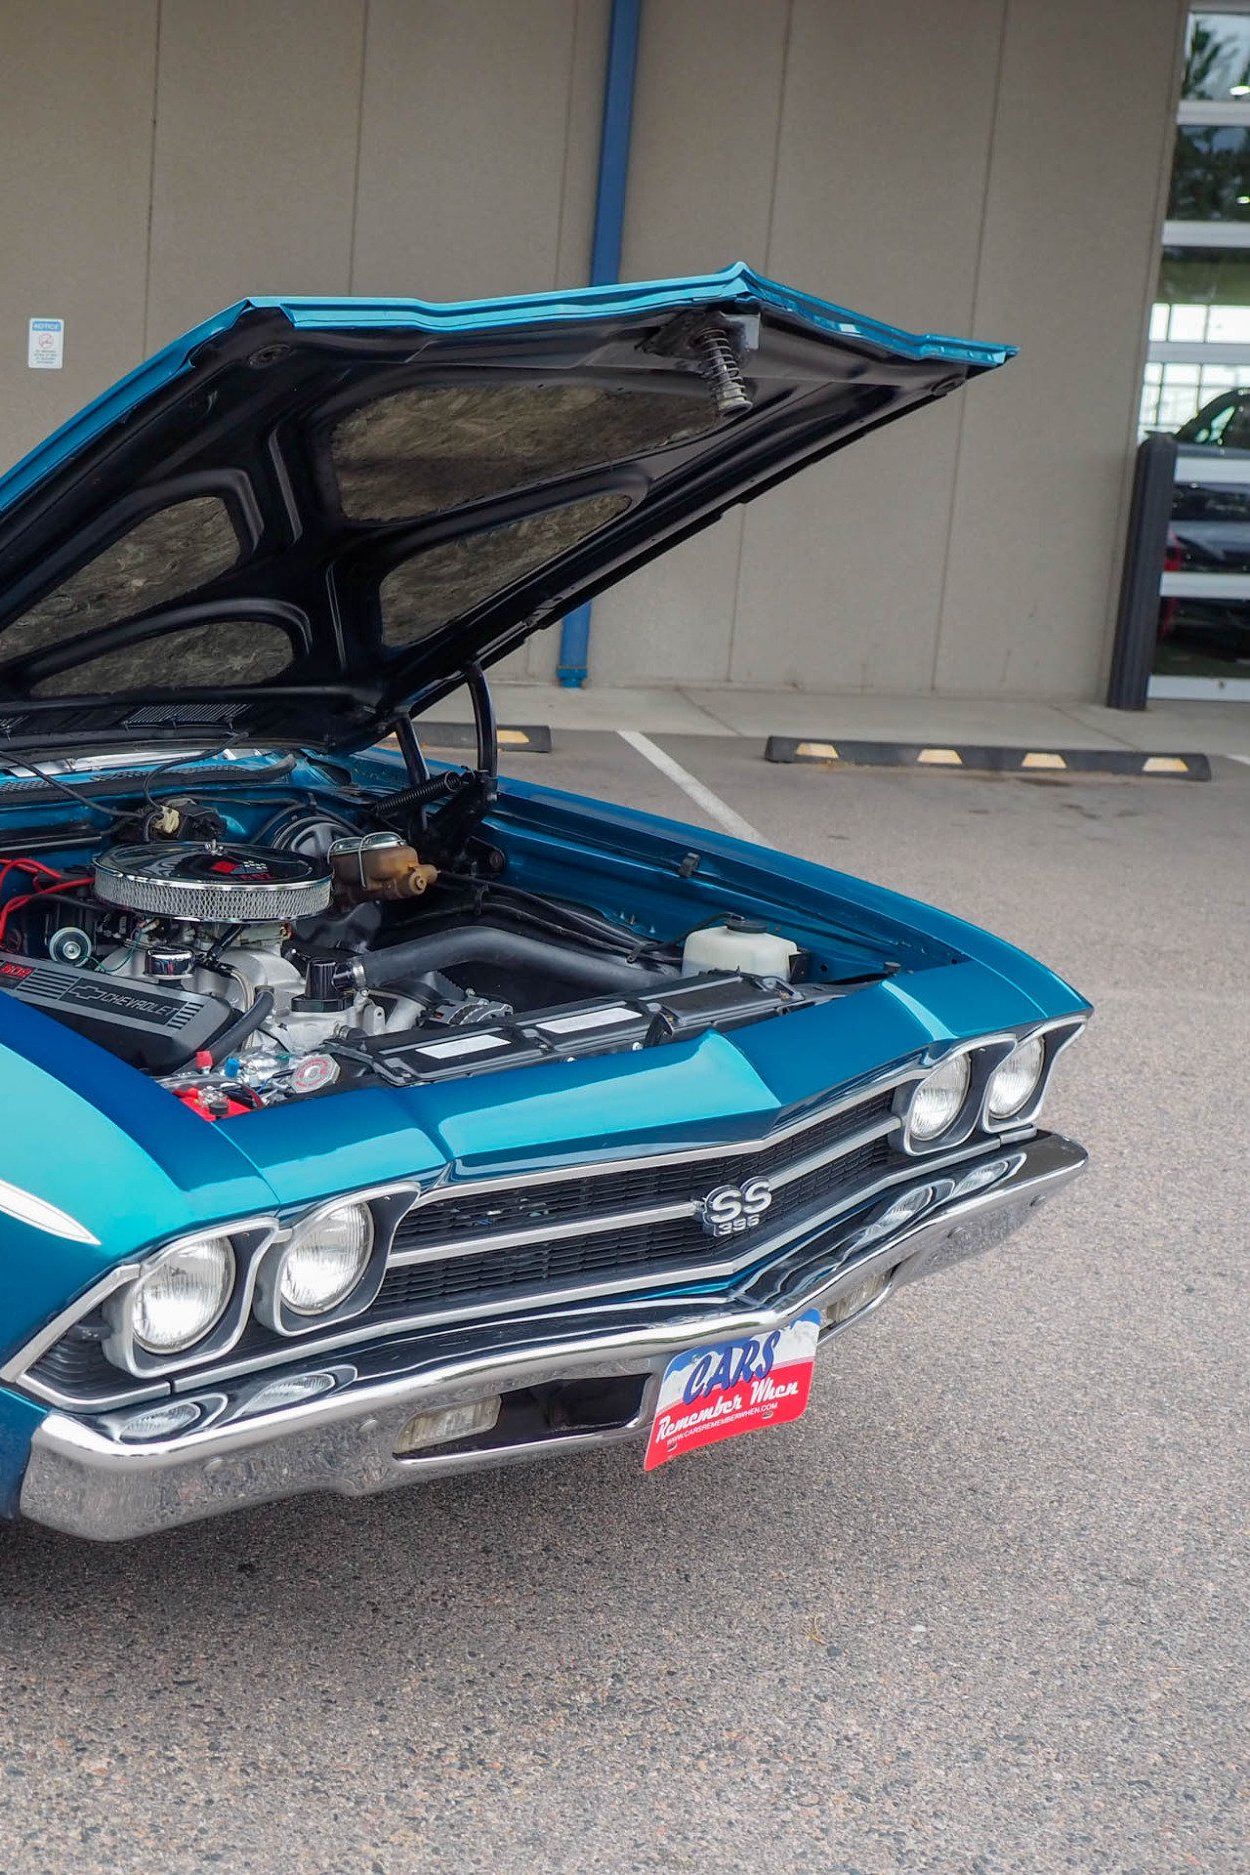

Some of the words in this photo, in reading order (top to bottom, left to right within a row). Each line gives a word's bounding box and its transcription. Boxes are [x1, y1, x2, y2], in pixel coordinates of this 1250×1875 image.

[100, 992, 180, 1017] CHEVROLET
[706, 1177, 772, 1224] SS
[717, 1213, 761, 1236] 396
[681, 1330, 782, 1405] CARS
[655, 1395, 743, 1444] Remember
[749, 1376, 799, 1406] When
